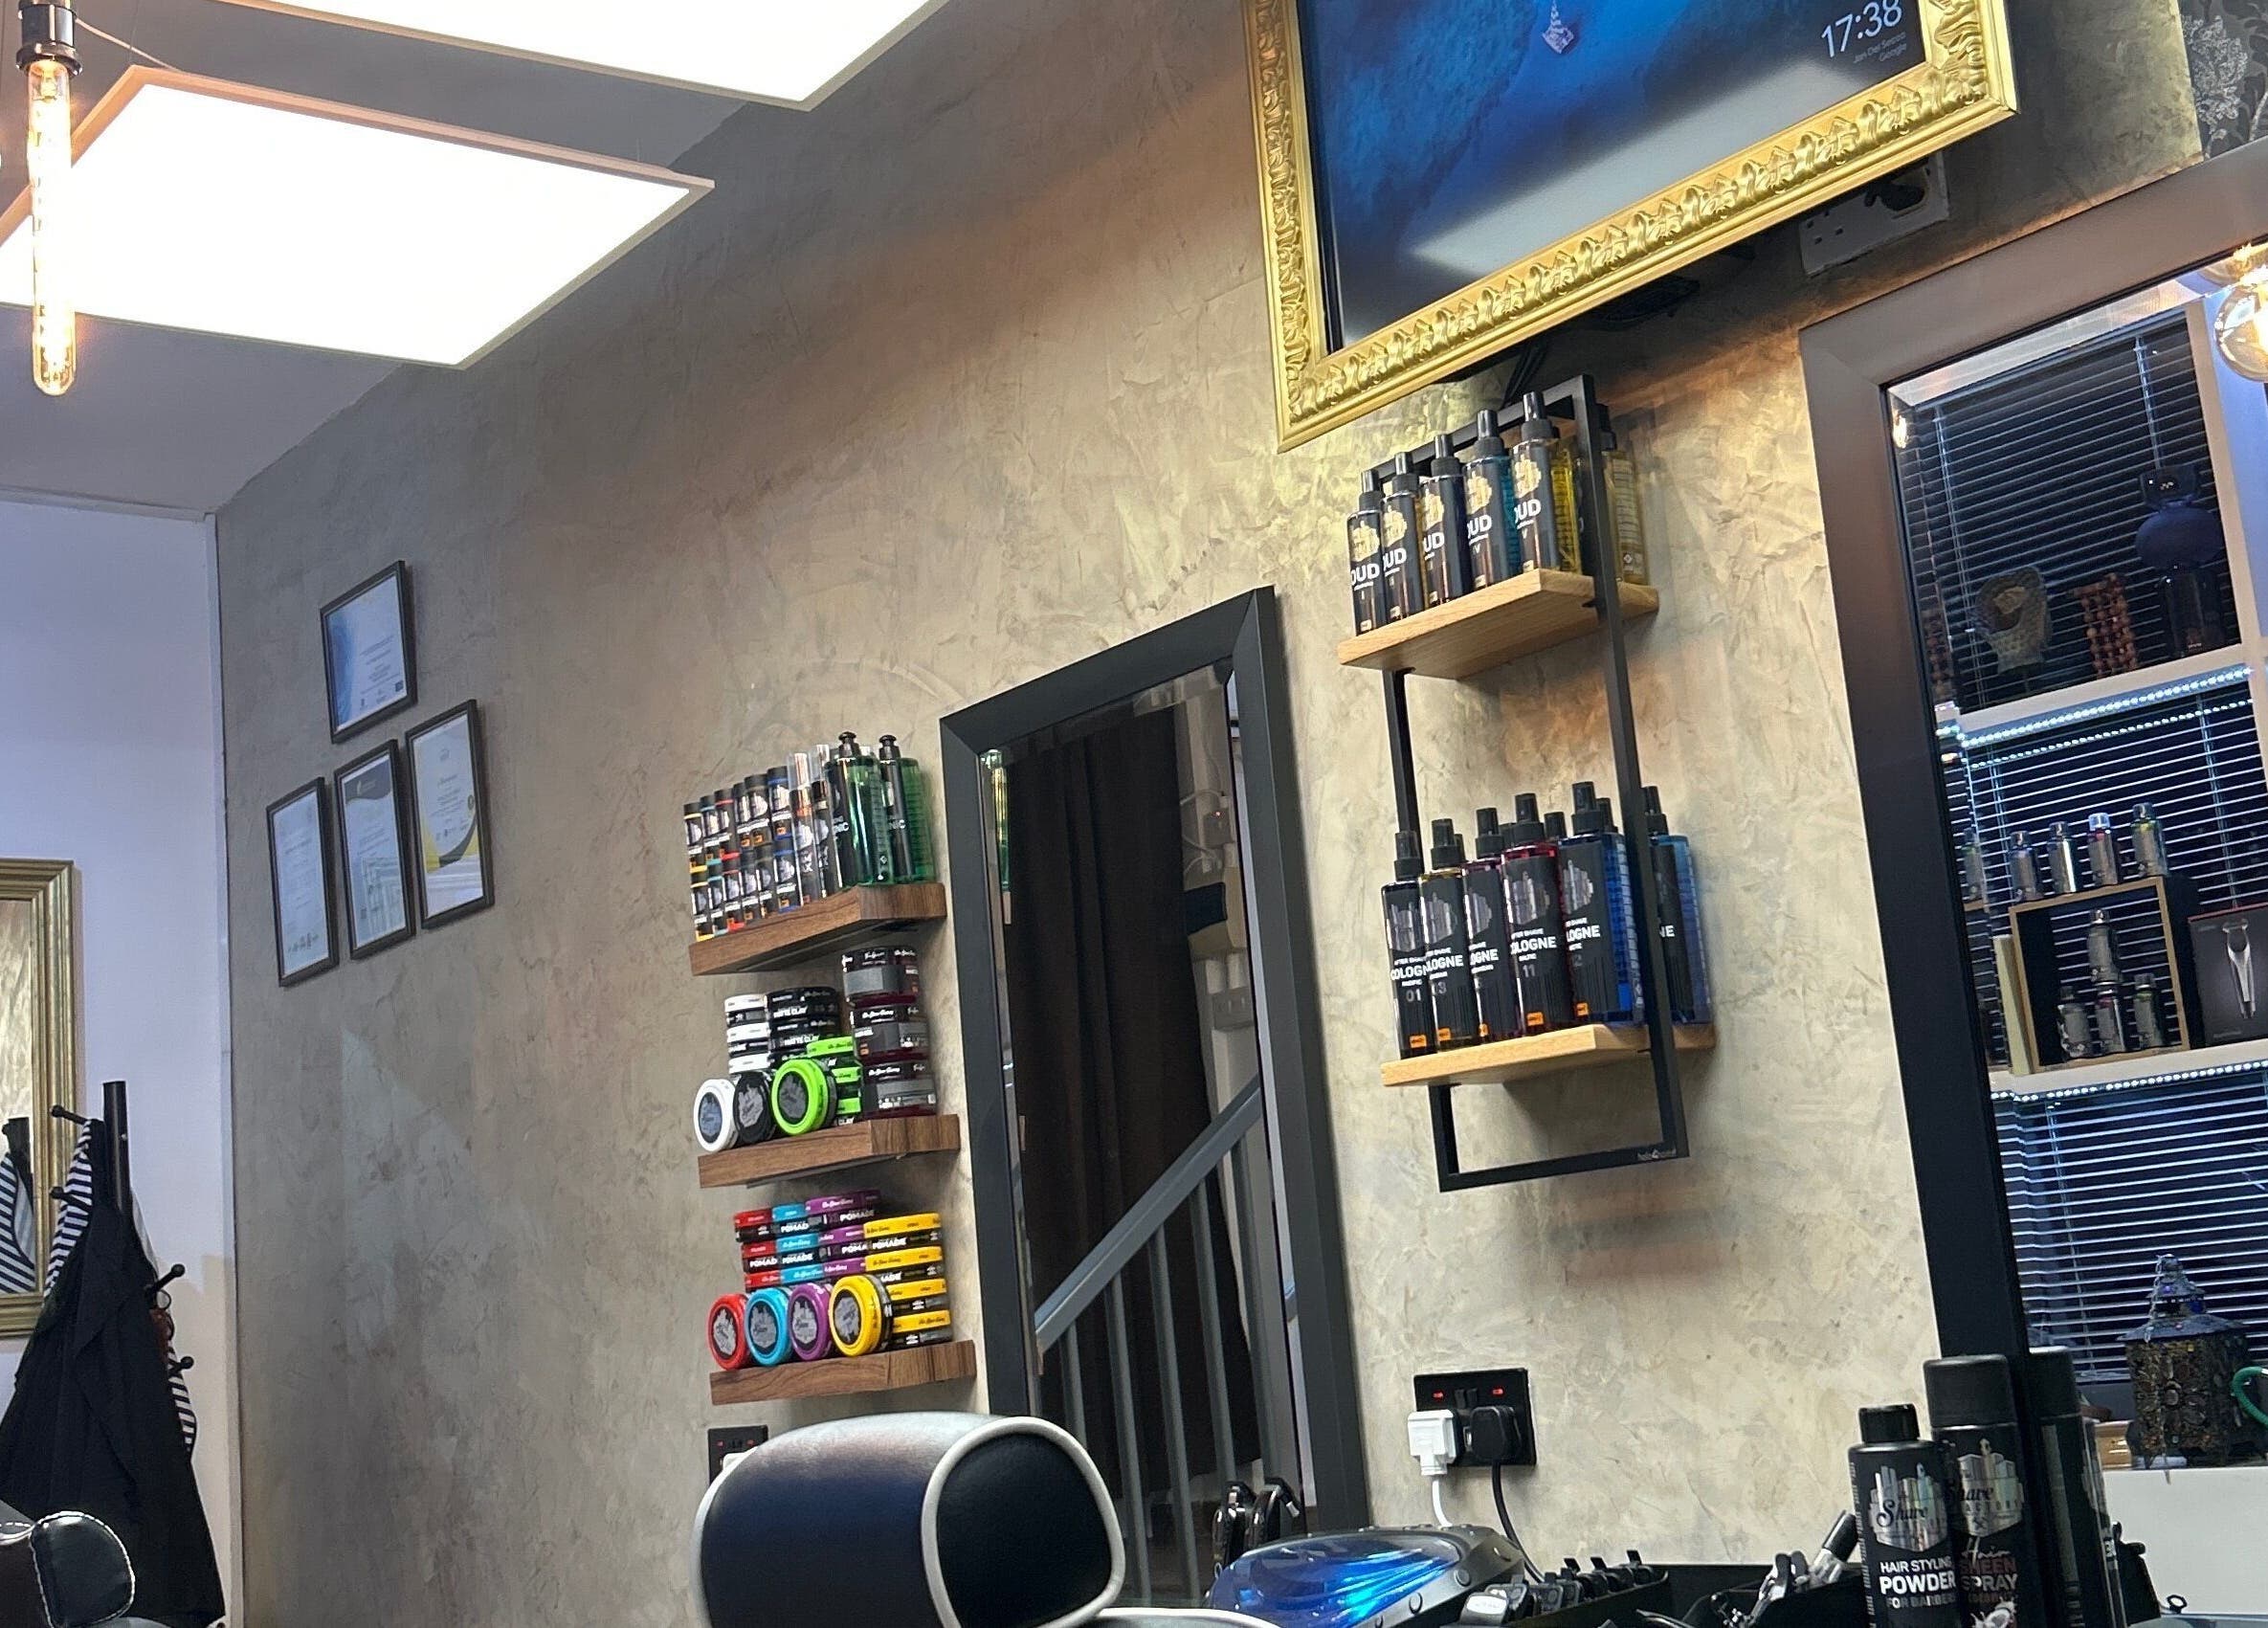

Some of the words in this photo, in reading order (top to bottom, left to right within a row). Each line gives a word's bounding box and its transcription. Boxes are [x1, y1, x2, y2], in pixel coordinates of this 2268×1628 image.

[1821, 0, 1902, 57] 17:38
[1423, 531, 1445, 552] UD
[1567, 925, 1601, 943] LOGNE
[1426, 954, 1464, 972] LOGNE
[1390, 965, 1428, 981] COLOGN
[1406, 989, 1422, 1002] 01
[781, 1222, 810, 1234] POMAD
[842, 1243, 868, 1255] POMA
[749, 1258, 778, 1268] POMAD
[1879, 1561, 1910, 1573] HAIR
[1879, 1570, 1957, 1595] POWDER
[1961, 1572, 2018, 1593] SPRAY
[1886, 1596, 1909, 1609] FOR
